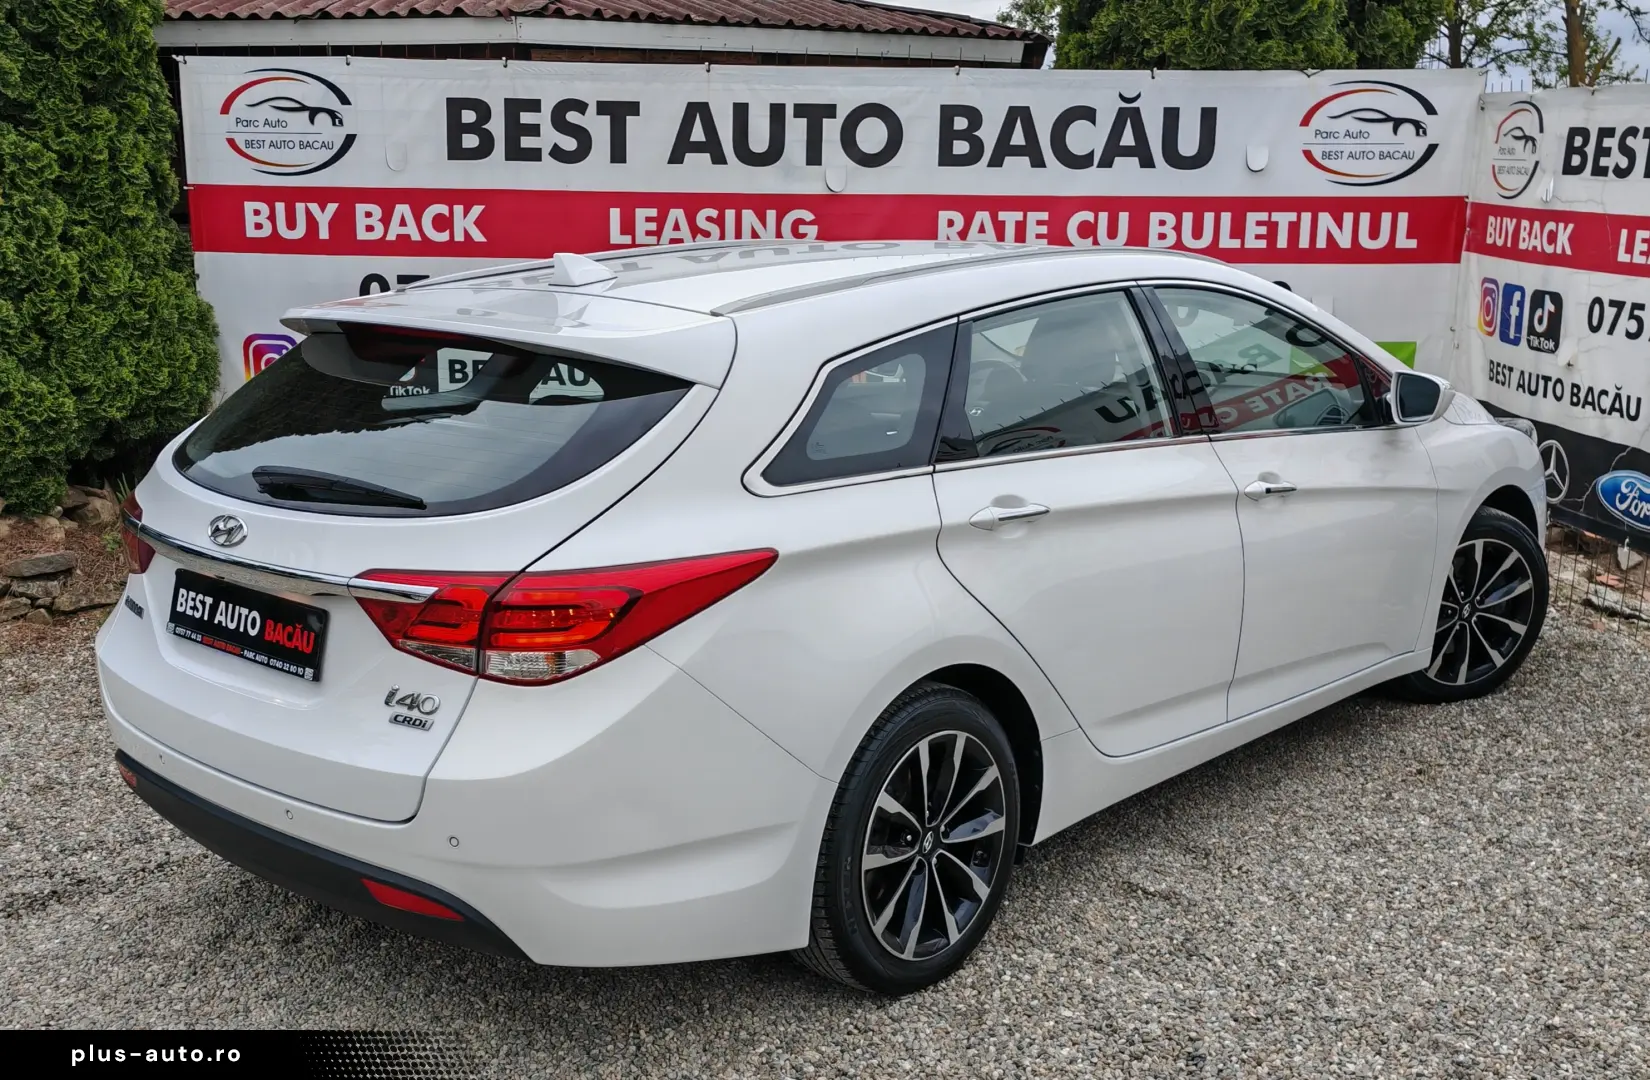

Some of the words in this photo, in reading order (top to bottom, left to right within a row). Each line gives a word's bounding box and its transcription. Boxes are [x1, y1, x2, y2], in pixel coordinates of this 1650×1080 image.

[235, 117, 260, 128] Parc
[263, 118, 288, 128] Auto
[446, 97, 640, 164] BEST
[667, 102, 904, 168] AUTO
[937, 92, 1218, 171] BACĂU
[1314, 129, 1340, 140] Parc
[1343, 129, 1370, 140] Auto
[244, 139, 266, 150] BEST
[268, 139, 296, 150] AUTO
[299, 140, 334, 150] BACAU
[1321, 150, 1344, 161] BEST
[1347, 150, 1376, 161] AUTO
[1378, 150, 1415, 161] BACAU
[244, 200, 339, 240] BUY
[355, 203, 487, 243] BACK
[609, 207, 819, 244] LEASING
[937, 210, 1049, 245] RATE
[1066, 210, 1129, 247] CU
[1147, 211, 1418, 249] BULETINUL
[1486, 215, 1517, 248] BUY
[1518, 218, 1574, 255] BACK
[1617, 228, 1650, 264] LE
[1587, 296, 1650, 342] 075
[1529, 335, 1556, 352] TikTok
[1488, 359, 1514, 388] BEST
[1516, 369, 1565, 403] AUTO
[1570, 382, 1642, 422] BACĂU
[176, 587, 213, 621] BEST
[214, 600, 261, 637] AUTO
[264, 618, 315, 654] BACĂU
[243, 649, 255, 660] PARC
[255, 653, 268, 664] AUTO
[384, 684, 441, 716] i40
[393, 714, 429, 729] CRDi
